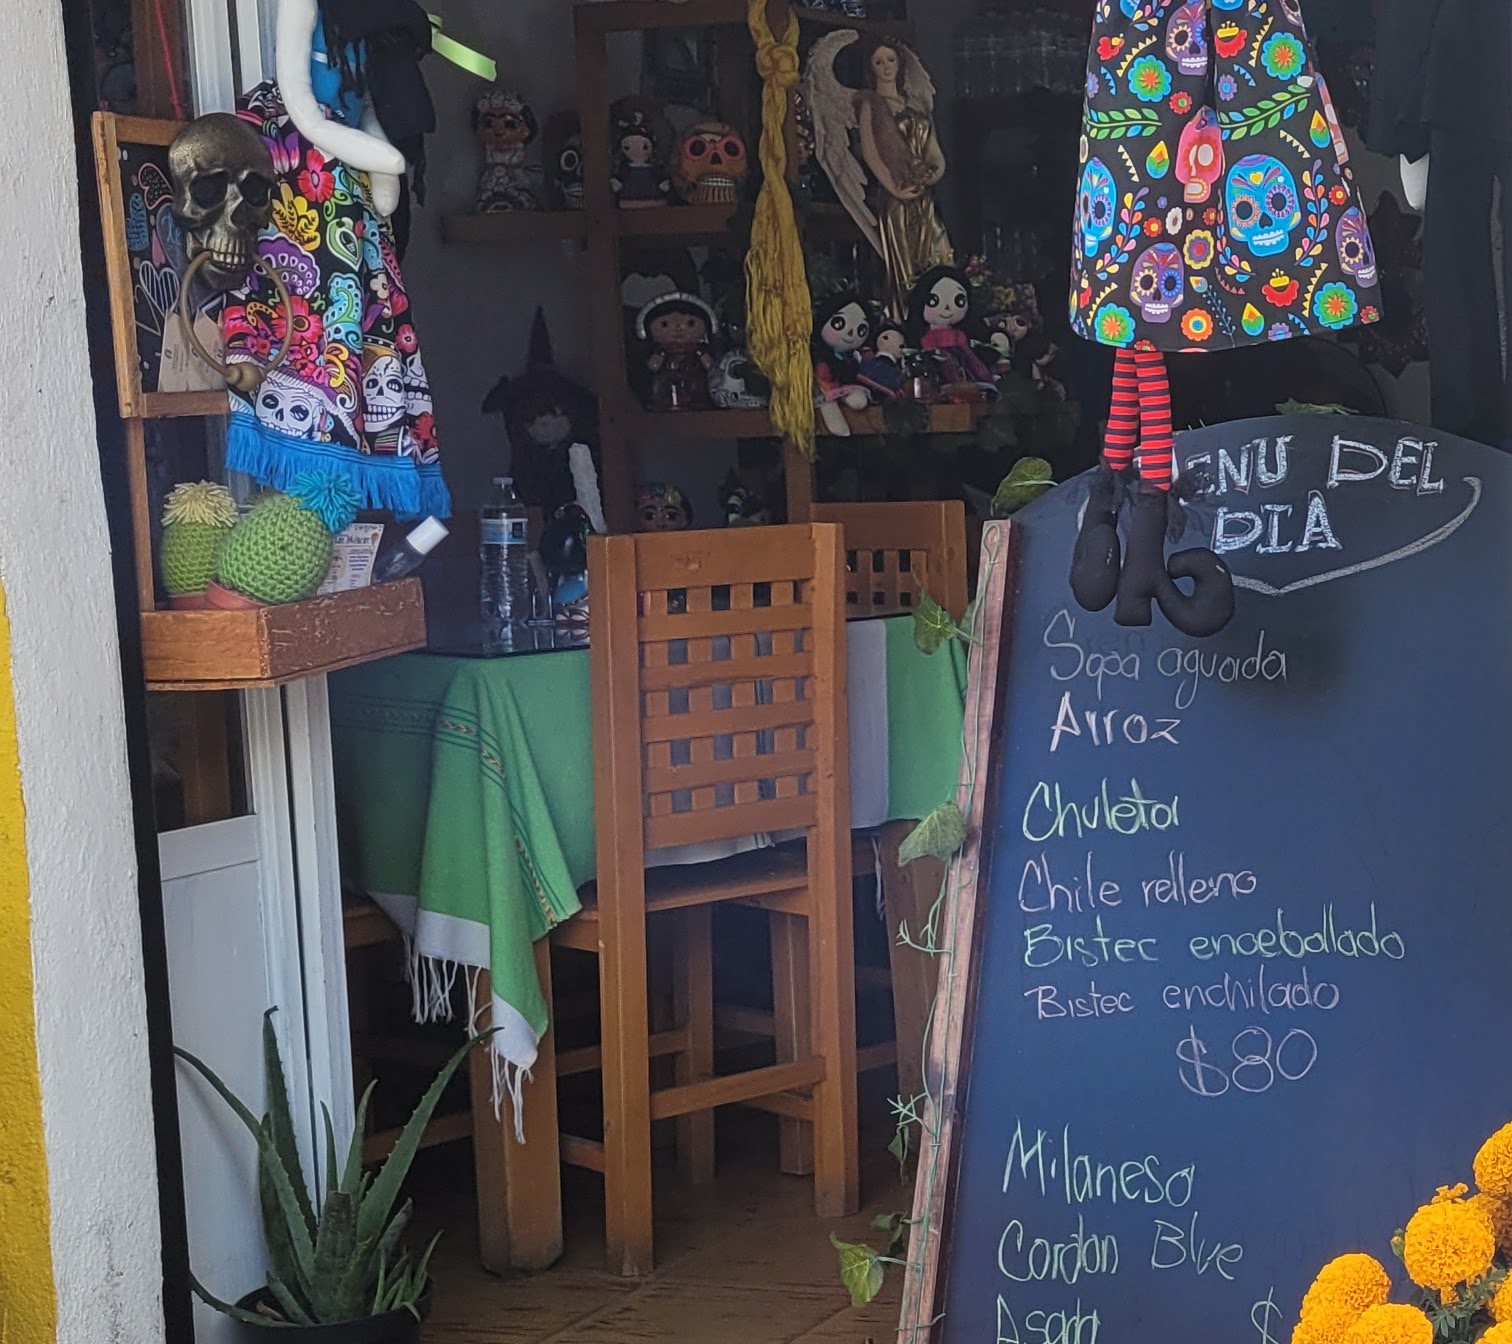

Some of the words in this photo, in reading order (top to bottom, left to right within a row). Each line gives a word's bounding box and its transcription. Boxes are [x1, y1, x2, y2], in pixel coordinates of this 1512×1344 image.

[1133, 434, 1294, 496] ENU
[1326, 434, 1446, 496] DEL
[1210, 489, 1343, 555] DIA
[1157, 630, 1288, 710] aguada
[1050, 690, 1181, 753] Arroz
[1022, 777, 1180, 842] Chuleta
[1018, 849, 1123, 913] Chile
[1142, 849, 1257, 908] relleno
[1023, 914, 1159, 968] Bistec
[1023, 980, 1135, 1020] Bistec
[1162, 963, 1340, 1015] enchilado
[1176, 1025, 1319, 1097] $80
[1002, 1116, 1196, 1208] Milanesa
[998, 1212, 1119, 1285] Cordon
[1151, 1210, 1244, 1281] Blue
